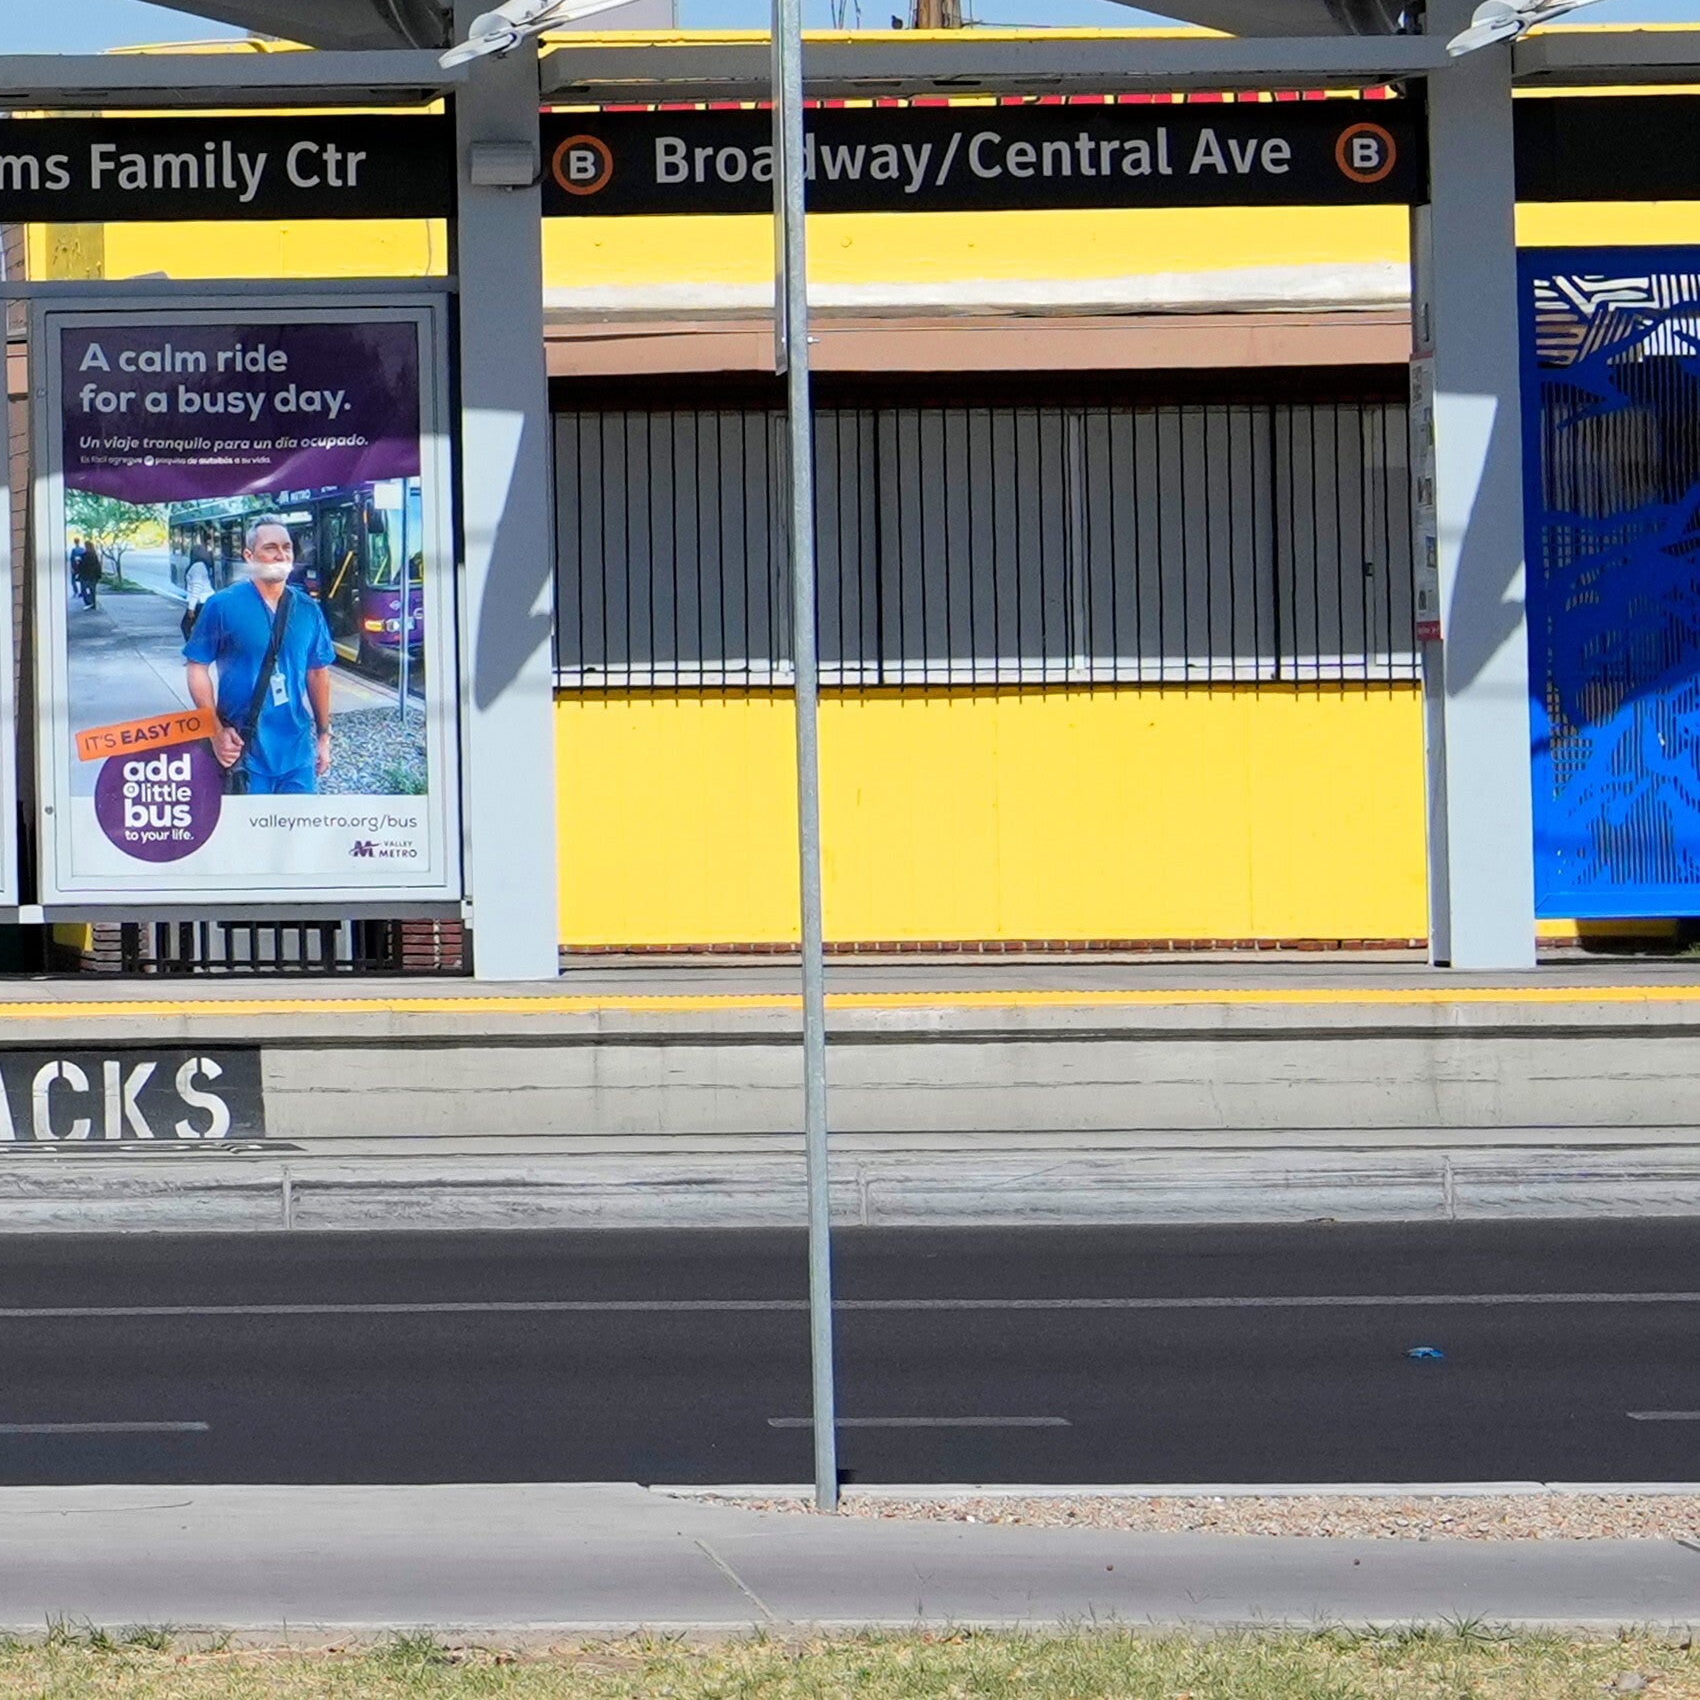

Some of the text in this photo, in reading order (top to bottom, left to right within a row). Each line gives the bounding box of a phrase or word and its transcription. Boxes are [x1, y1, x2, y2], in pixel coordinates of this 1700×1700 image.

[91, 140, 267, 202] Family
[286, 141, 366, 188] Ctr
[571, 127, 1379, 193] B Broadway/Central Ave B
[78, 343, 288, 373] A calm ride
[79, 383, 352, 421] for a busy day.
[79, 436, 100, 449] Un
[104, 436, 140, 451] viaje
[143, 437, 211, 452] tranquilo
[214, 438, 250, 453] para
[253, 438, 272, 449] un
[301, 434, 369, 450] ocupado.
[120, 722, 171, 745] EASY
[176, 717, 200, 733] TO
[123, 753, 191, 781] add
[141, 782, 192, 802] little
[124, 798, 193, 828] bus
[249, 814, 418, 832] valleymetro.org/bus
[125, 829, 194, 844] to your life.
[378, 849, 418, 858] METRO
